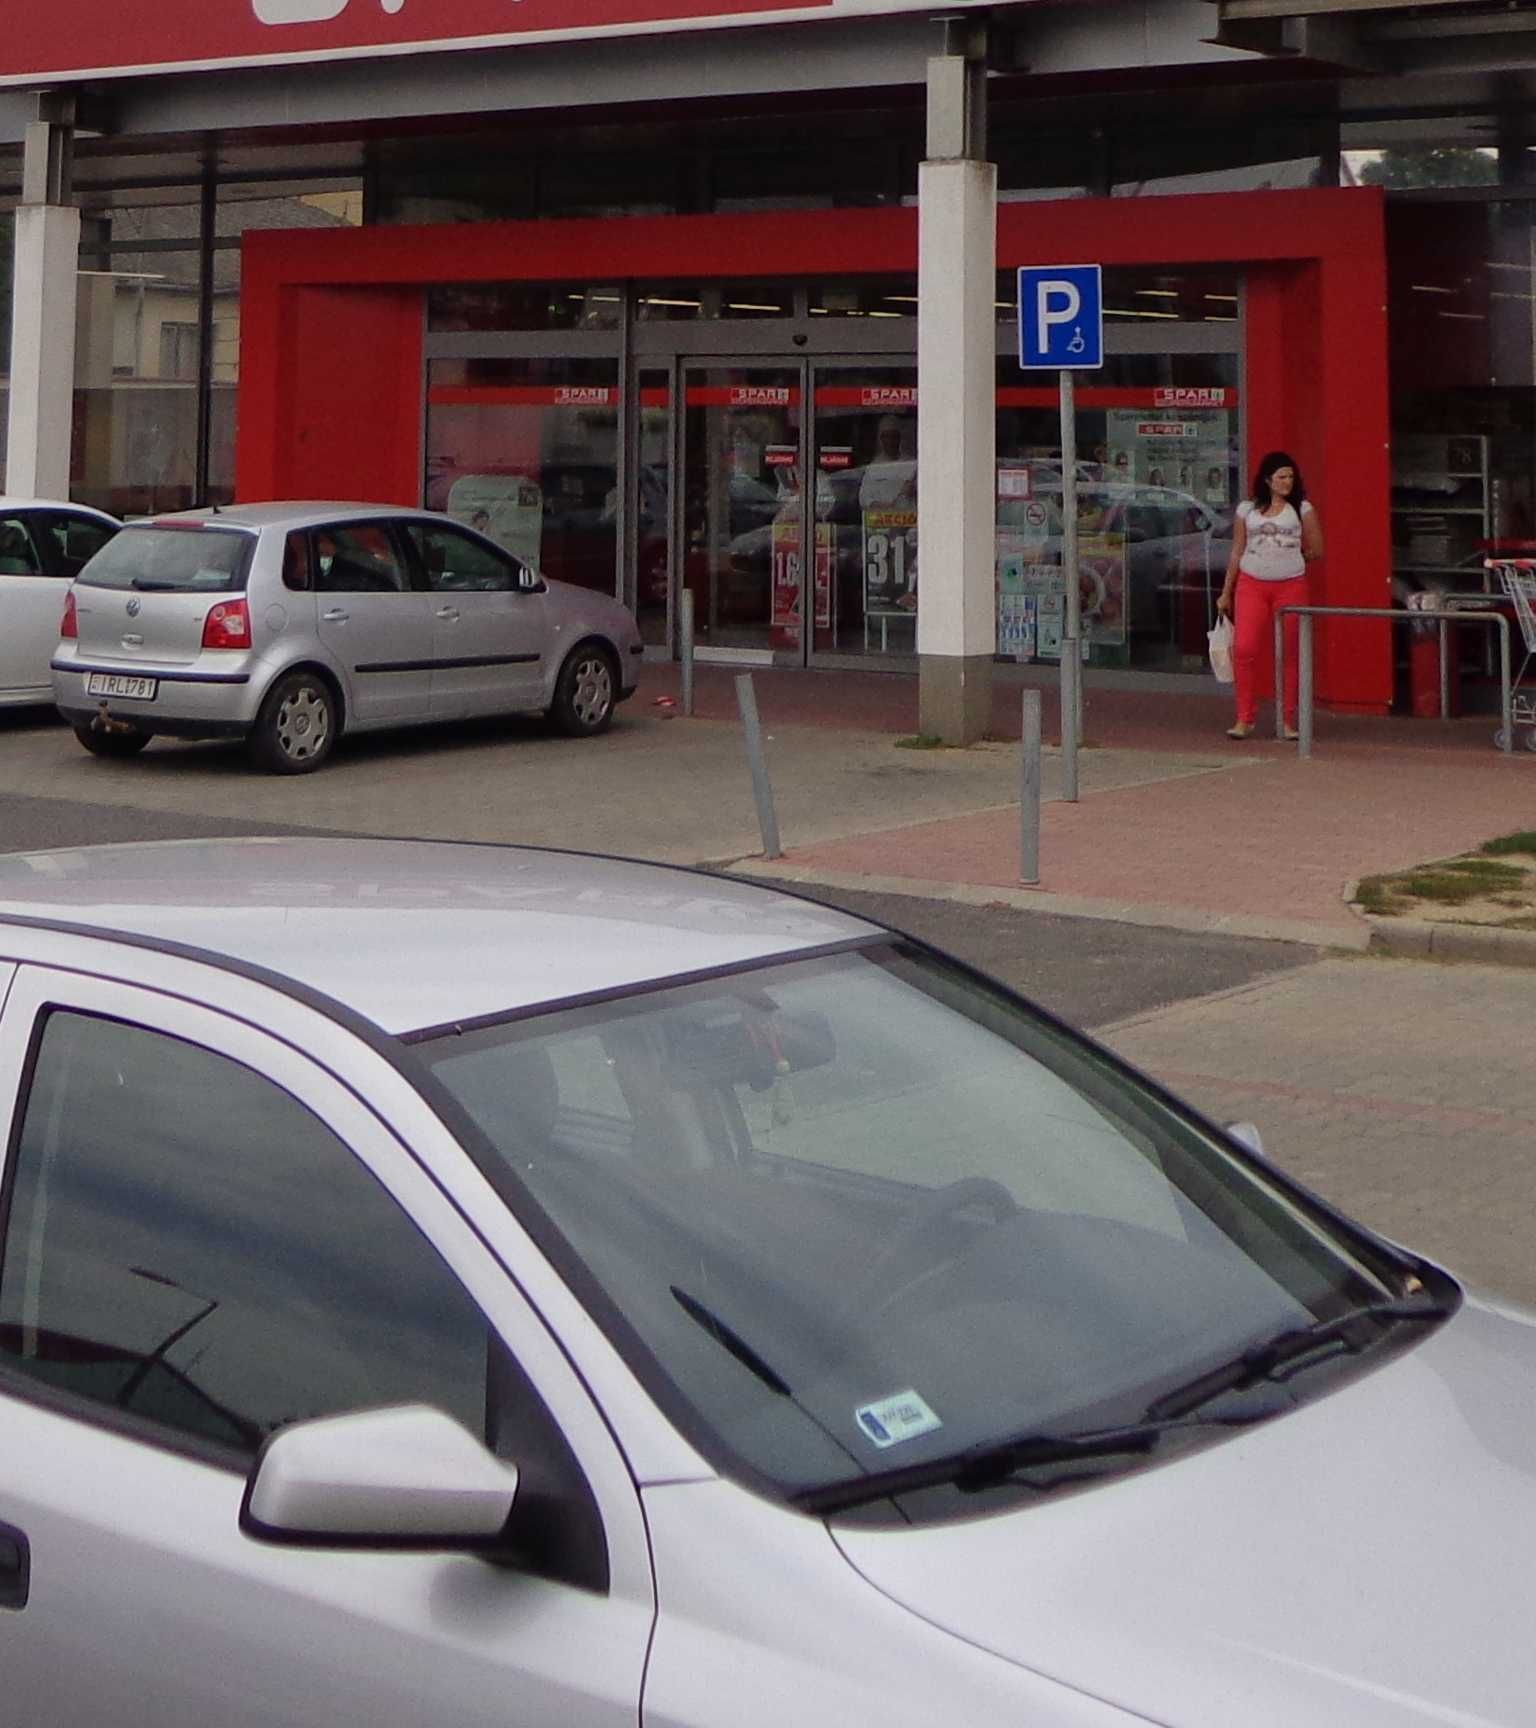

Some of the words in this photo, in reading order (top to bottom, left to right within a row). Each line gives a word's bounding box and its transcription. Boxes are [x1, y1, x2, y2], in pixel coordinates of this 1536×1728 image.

[1037, 280, 1081, 354] P
[561, 387, 599, 399] SPAR
[738, 387, 776, 400] SPAR
[870, 387, 910, 400] SPAR
[1163, 387, 1209, 400] SPAR
